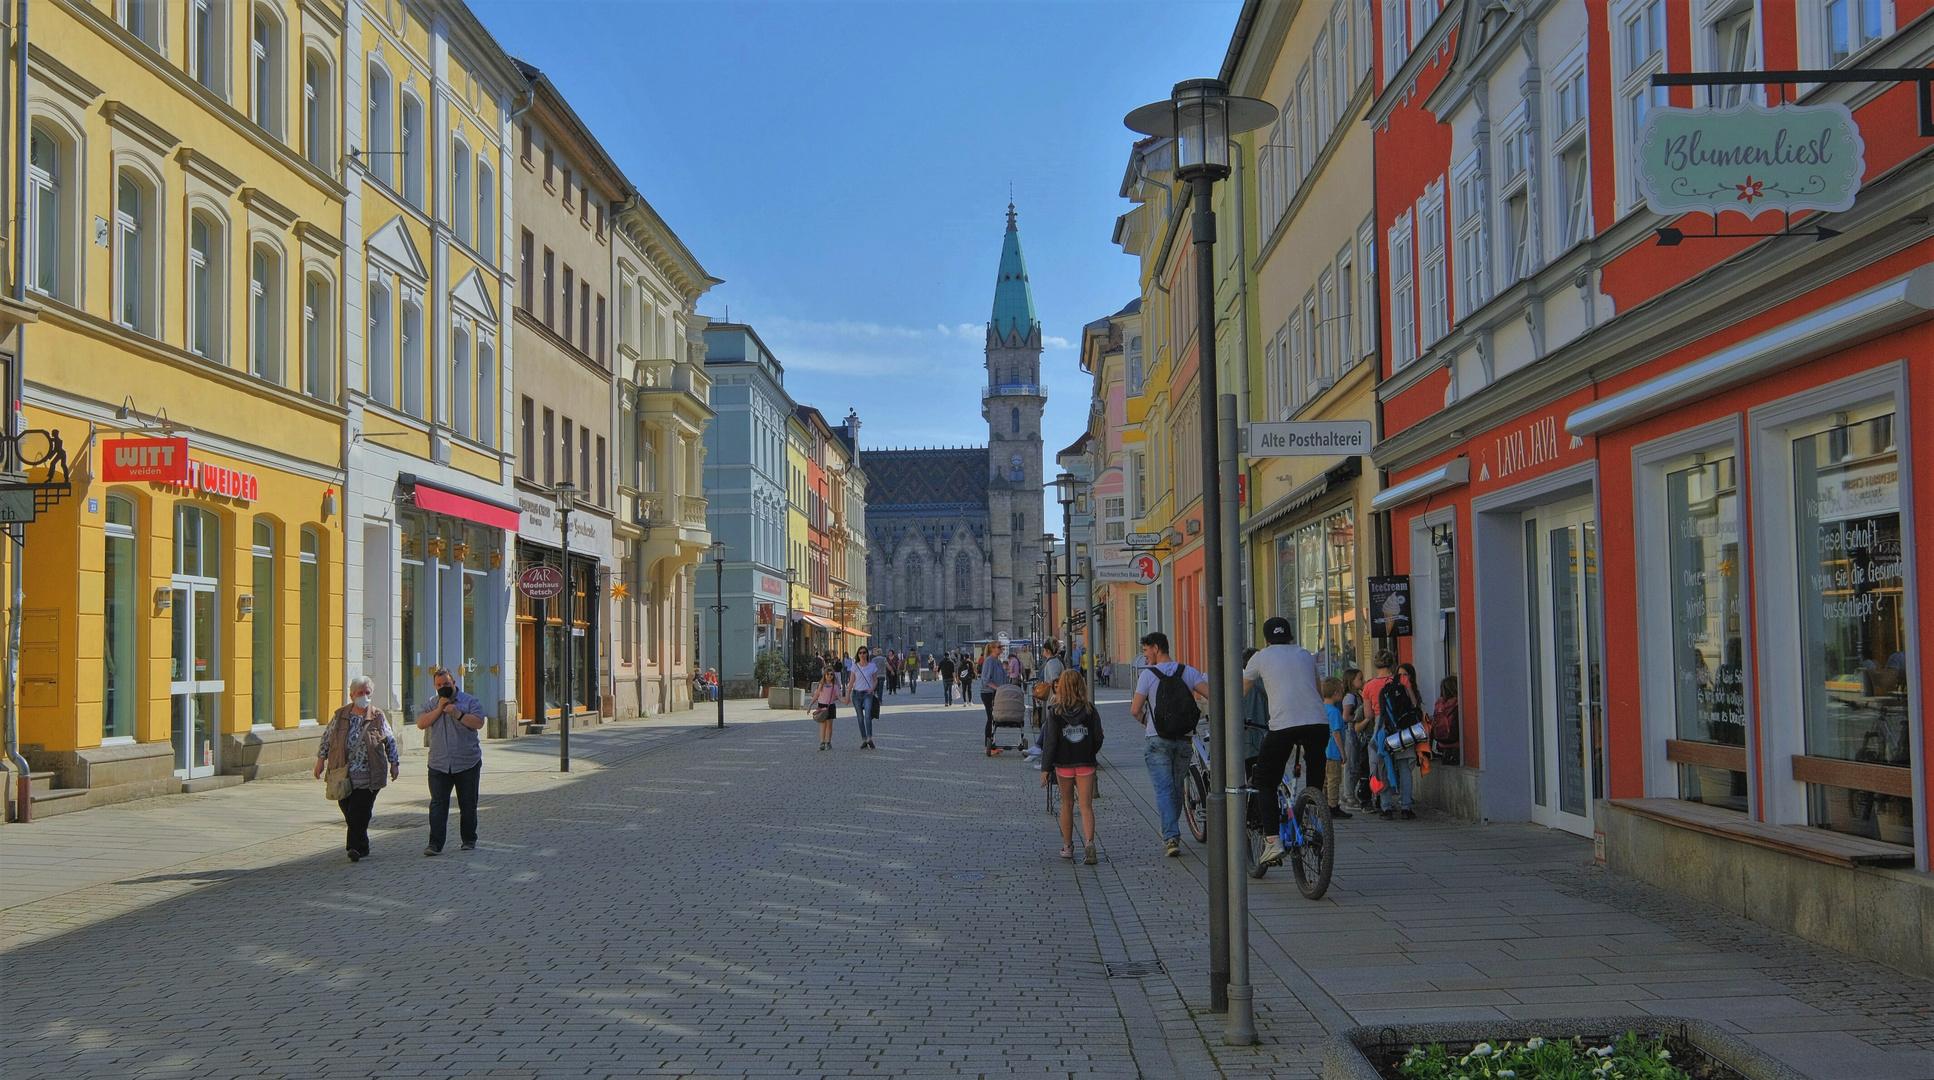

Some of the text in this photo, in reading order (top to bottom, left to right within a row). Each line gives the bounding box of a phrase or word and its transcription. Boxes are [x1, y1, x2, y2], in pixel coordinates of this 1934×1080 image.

[1664, 127, 1833, 171] Blumenliesl
[1261, 431, 1362, 448] Alte Posthalterei
[1496, 416, 1559, 478] LAVA JAVA
[115, 446, 175, 467] WITT
[129, 467, 162, 475] weiden
[200, 462, 258, 503] WEIDEN
[1100, 570, 1140, 580] Büchnersches Haus
[1835, 569, 1848, 586] sie
[1851, 562, 1865, 585] die
[1823, 593, 1873, 622] ausschließt
